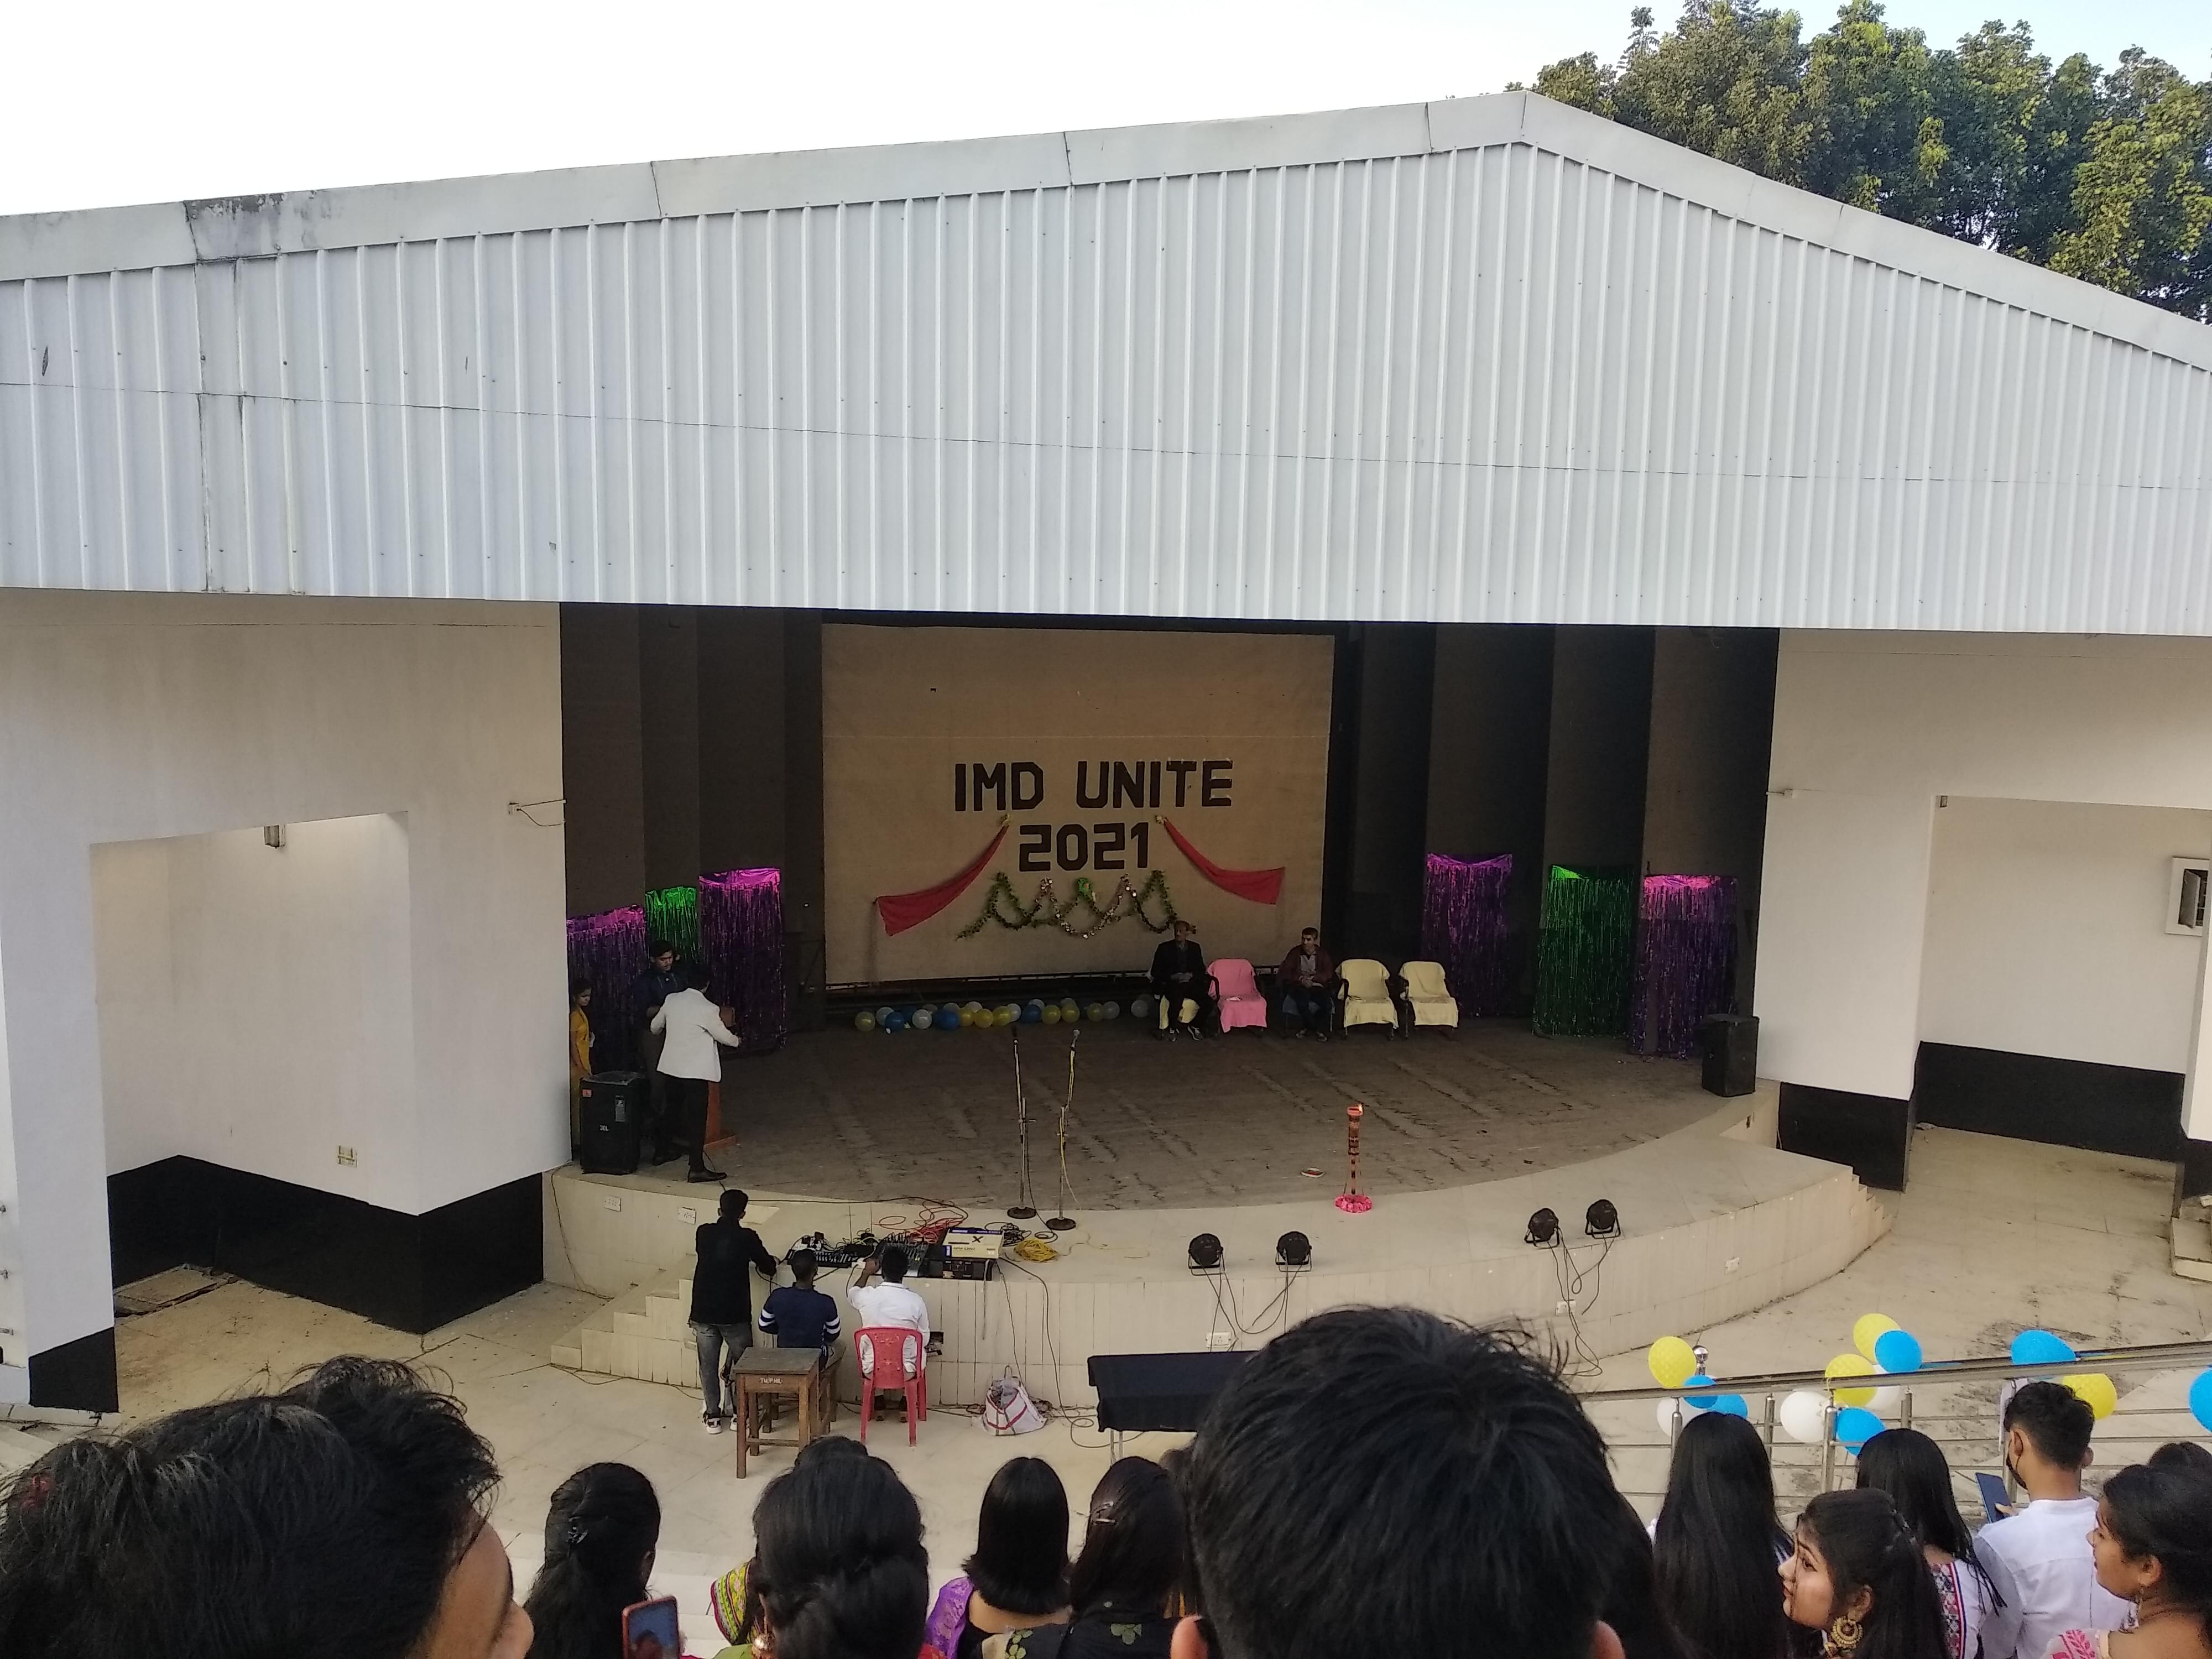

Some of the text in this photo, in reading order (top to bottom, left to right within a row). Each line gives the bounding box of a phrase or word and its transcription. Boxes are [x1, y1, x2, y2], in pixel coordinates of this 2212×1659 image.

[954, 760, 1233, 812] IMD UNITE
[1019, 822, 1149, 872] 2021
